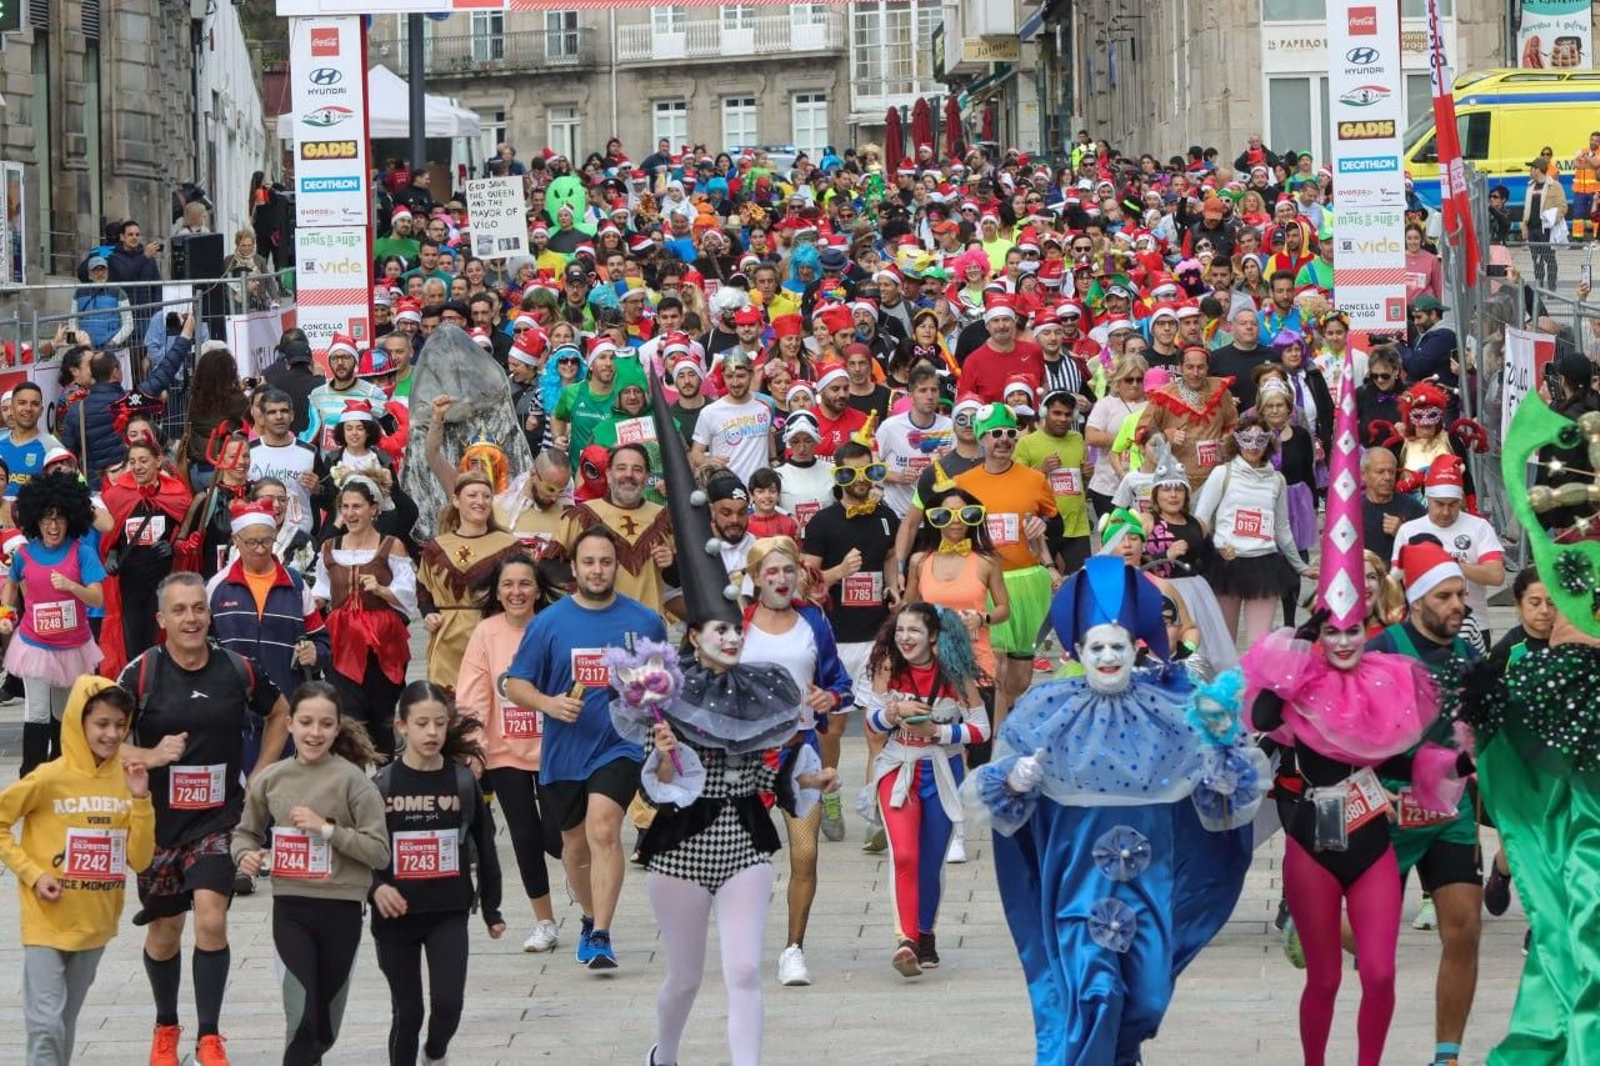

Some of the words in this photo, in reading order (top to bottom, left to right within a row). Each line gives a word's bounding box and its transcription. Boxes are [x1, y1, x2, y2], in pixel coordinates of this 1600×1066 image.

[1344, 66, 1385, 75] HYUNDAI
[307, 87, 347, 96] HYUNDAI
[1340, 122, 1394, 138] GADIS
[303, 143, 357, 158] GADIS
[1341, 159, 1395, 171] DECATHLON
[304, 179, 357, 190] DECATHLON
[468, 183, 486, 192] GOD
[489, 180, 508, 189] SAVE
[469, 192, 483, 200] THE
[487, 189, 515, 199] QUEEN
[471, 200, 486, 208] AND
[470, 209, 502, 218] MAYOR
[506, 207, 518, 216] OF
[473, 220, 498, 230] VIGO
[1374, 213, 1400, 227] auga
[337, 233, 361, 248] auga
[1358, 237, 1401, 254] vide
[319, 257, 362, 274] vide
[1339, 303, 1381, 312] CONCELLO
[1357, 310, 1376, 318] VIGO
[302, 323, 343, 331] CONCELLO
[757, 412, 768, 423] GO
[1238, 520, 1259, 532] 0157
[849, 589, 871, 601] 1785
[39, 618, 61, 630] 7248
[578, 667, 606, 681] 7317
[507, 719, 533, 732] 7241
[177, 787, 207, 802] 7240
[87, 816, 111, 824] VIBES
[425, 813, 440, 822] girl
[73, 853, 108, 872] 7242
[276, 851, 305, 870] 7244
[401, 854, 435, 871] 7243
